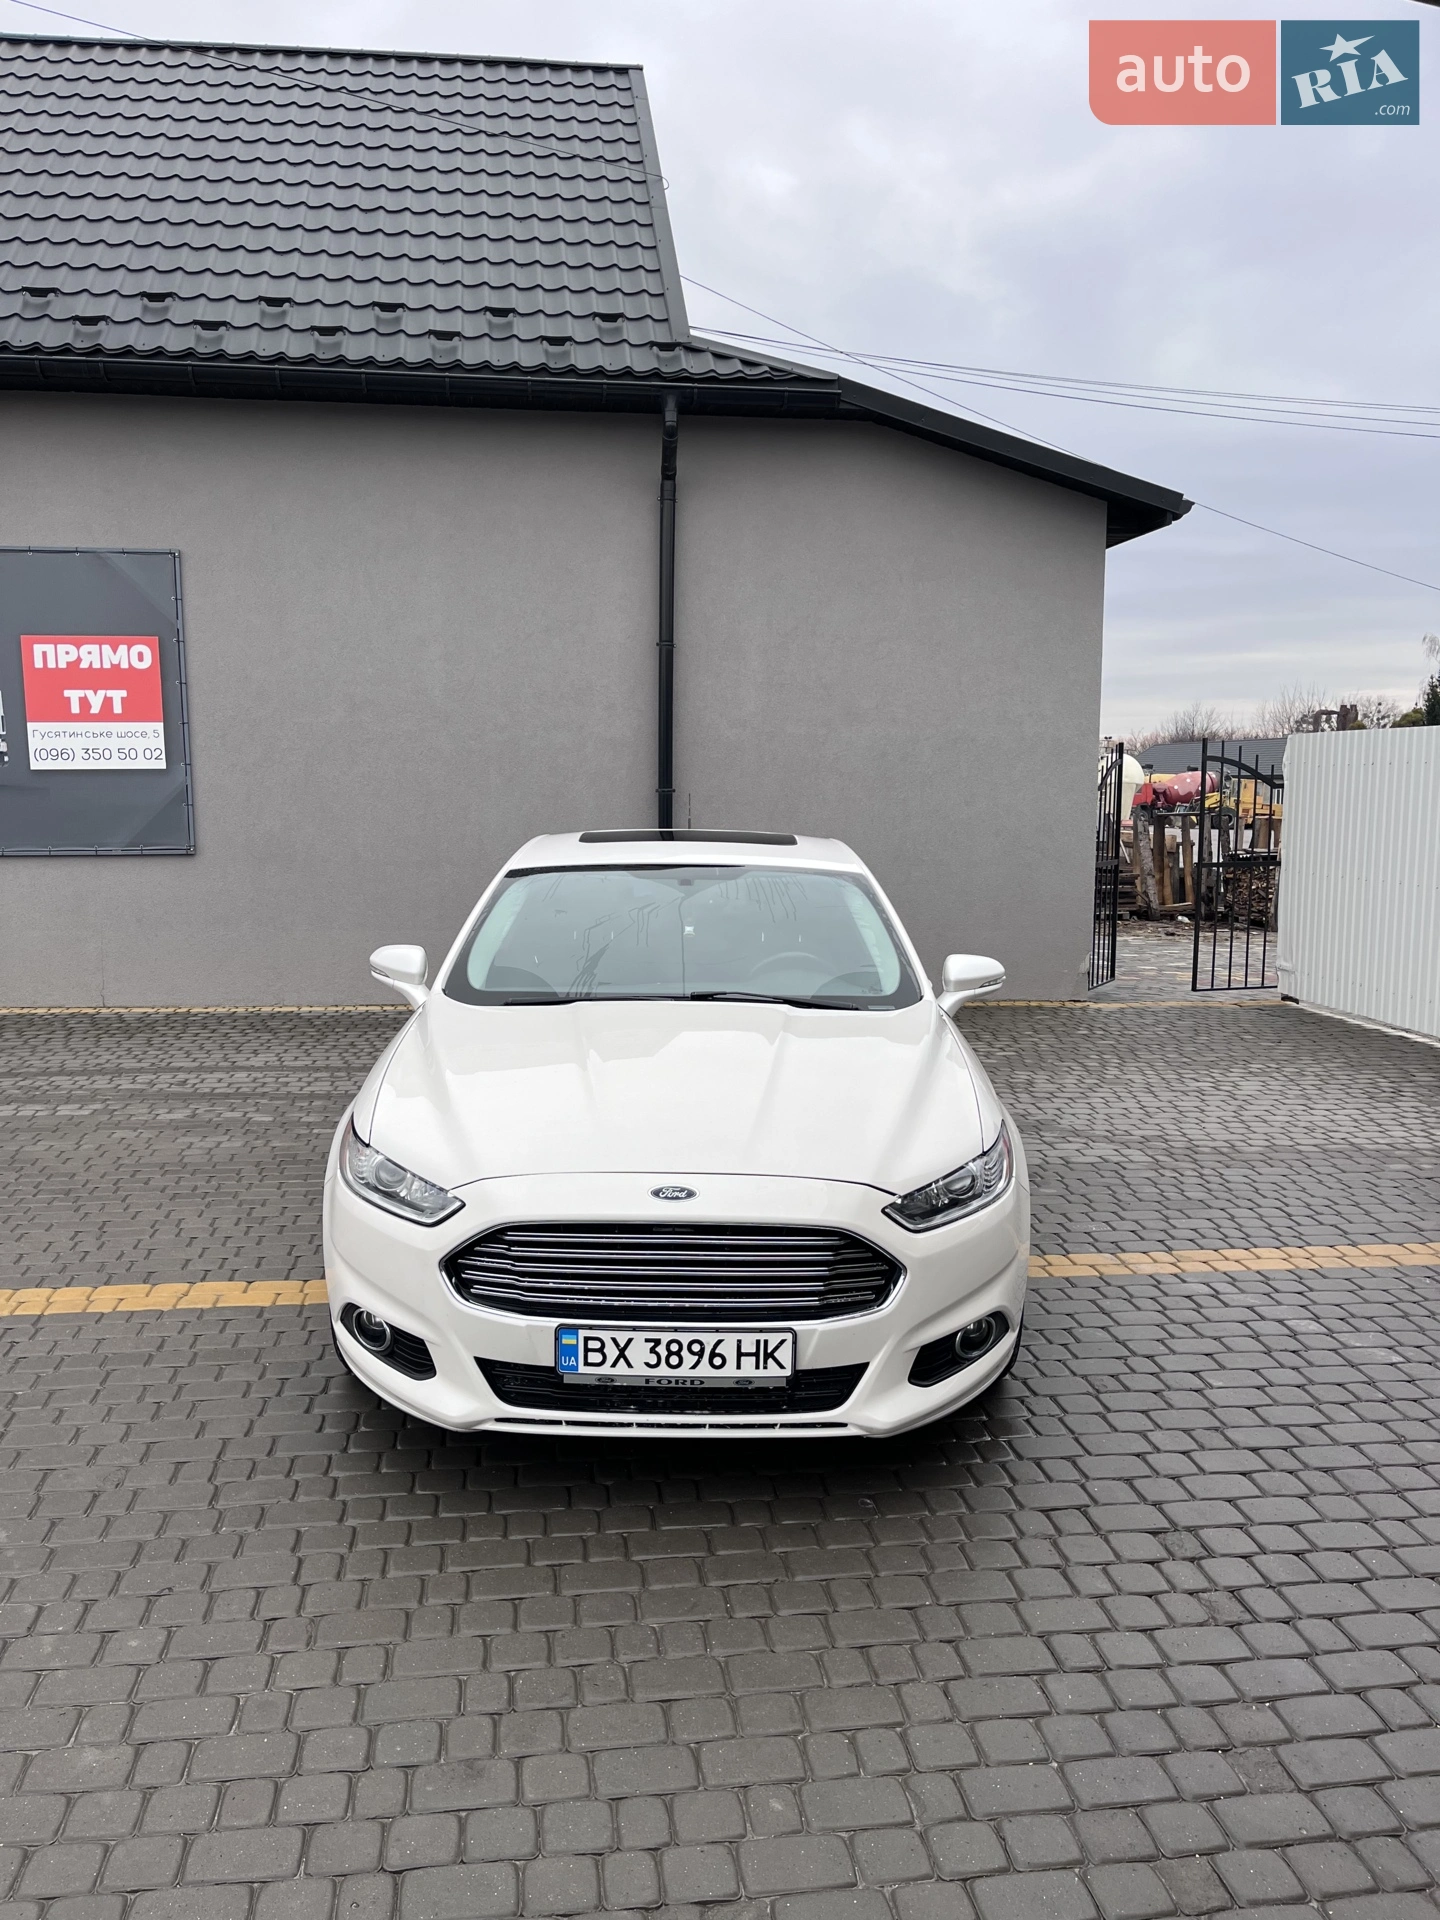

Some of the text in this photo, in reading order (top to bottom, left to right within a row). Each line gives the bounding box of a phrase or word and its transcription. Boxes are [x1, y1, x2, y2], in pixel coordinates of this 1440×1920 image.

[33, 644, 152, 669] ПРЯМО
[63, 689, 127, 714] ТУТ
[32, 729, 160, 740] Гусятинське шосе, 5
[33, 747, 164, 762] (096) 350 50 02
[659, 1187, 688, 1198] Ford
[583, 1336, 788, 1370] BX 3896 HK
[562, 1356, 577, 1366] UA
